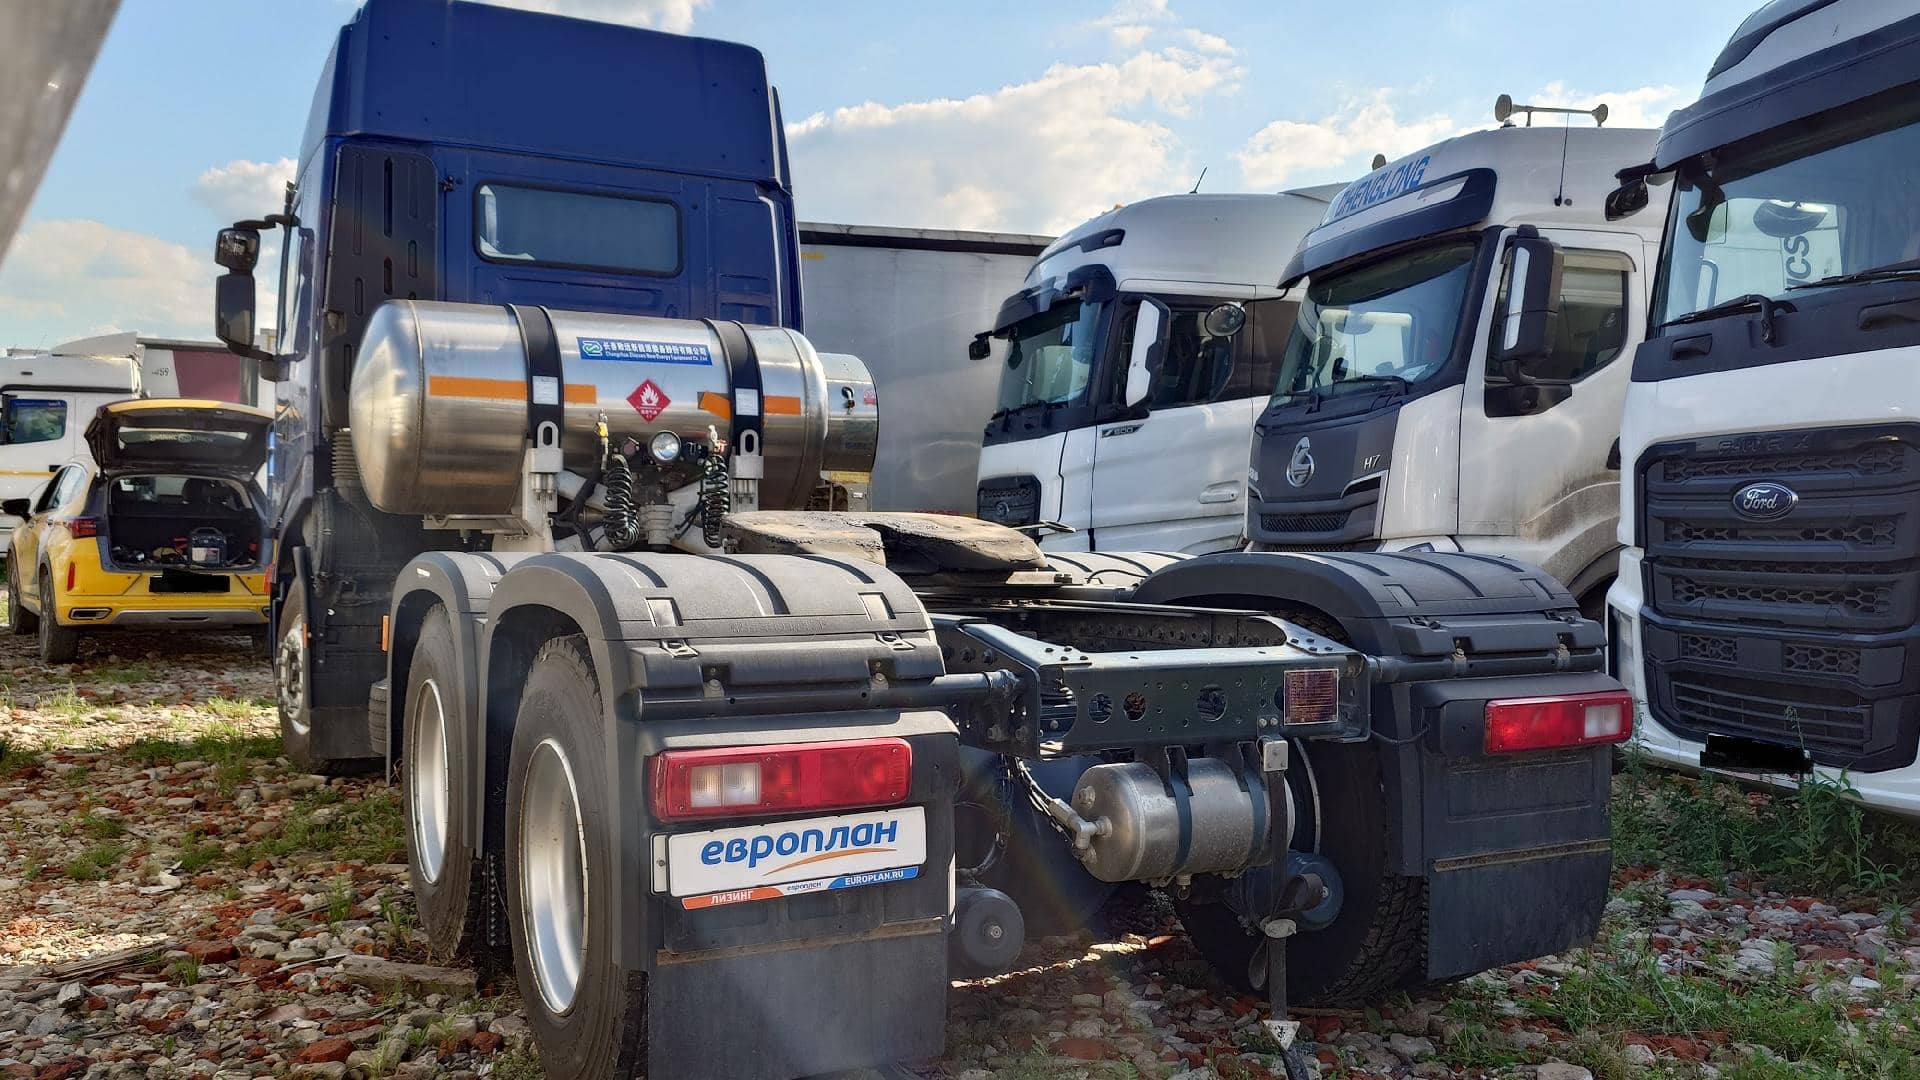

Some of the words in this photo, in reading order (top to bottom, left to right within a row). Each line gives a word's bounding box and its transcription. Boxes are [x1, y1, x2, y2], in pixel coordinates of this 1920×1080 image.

[1334, 155, 1431, 218] CHENGLONG
[1363, 454, 1381, 470] H7
[1743, 488, 1779, 510] Ford
[701, 820, 898, 869] европлан
[710, 890, 755, 905] ЛИЗИНГ
[845, 870, 904, 886] EUROPLAN.RU
